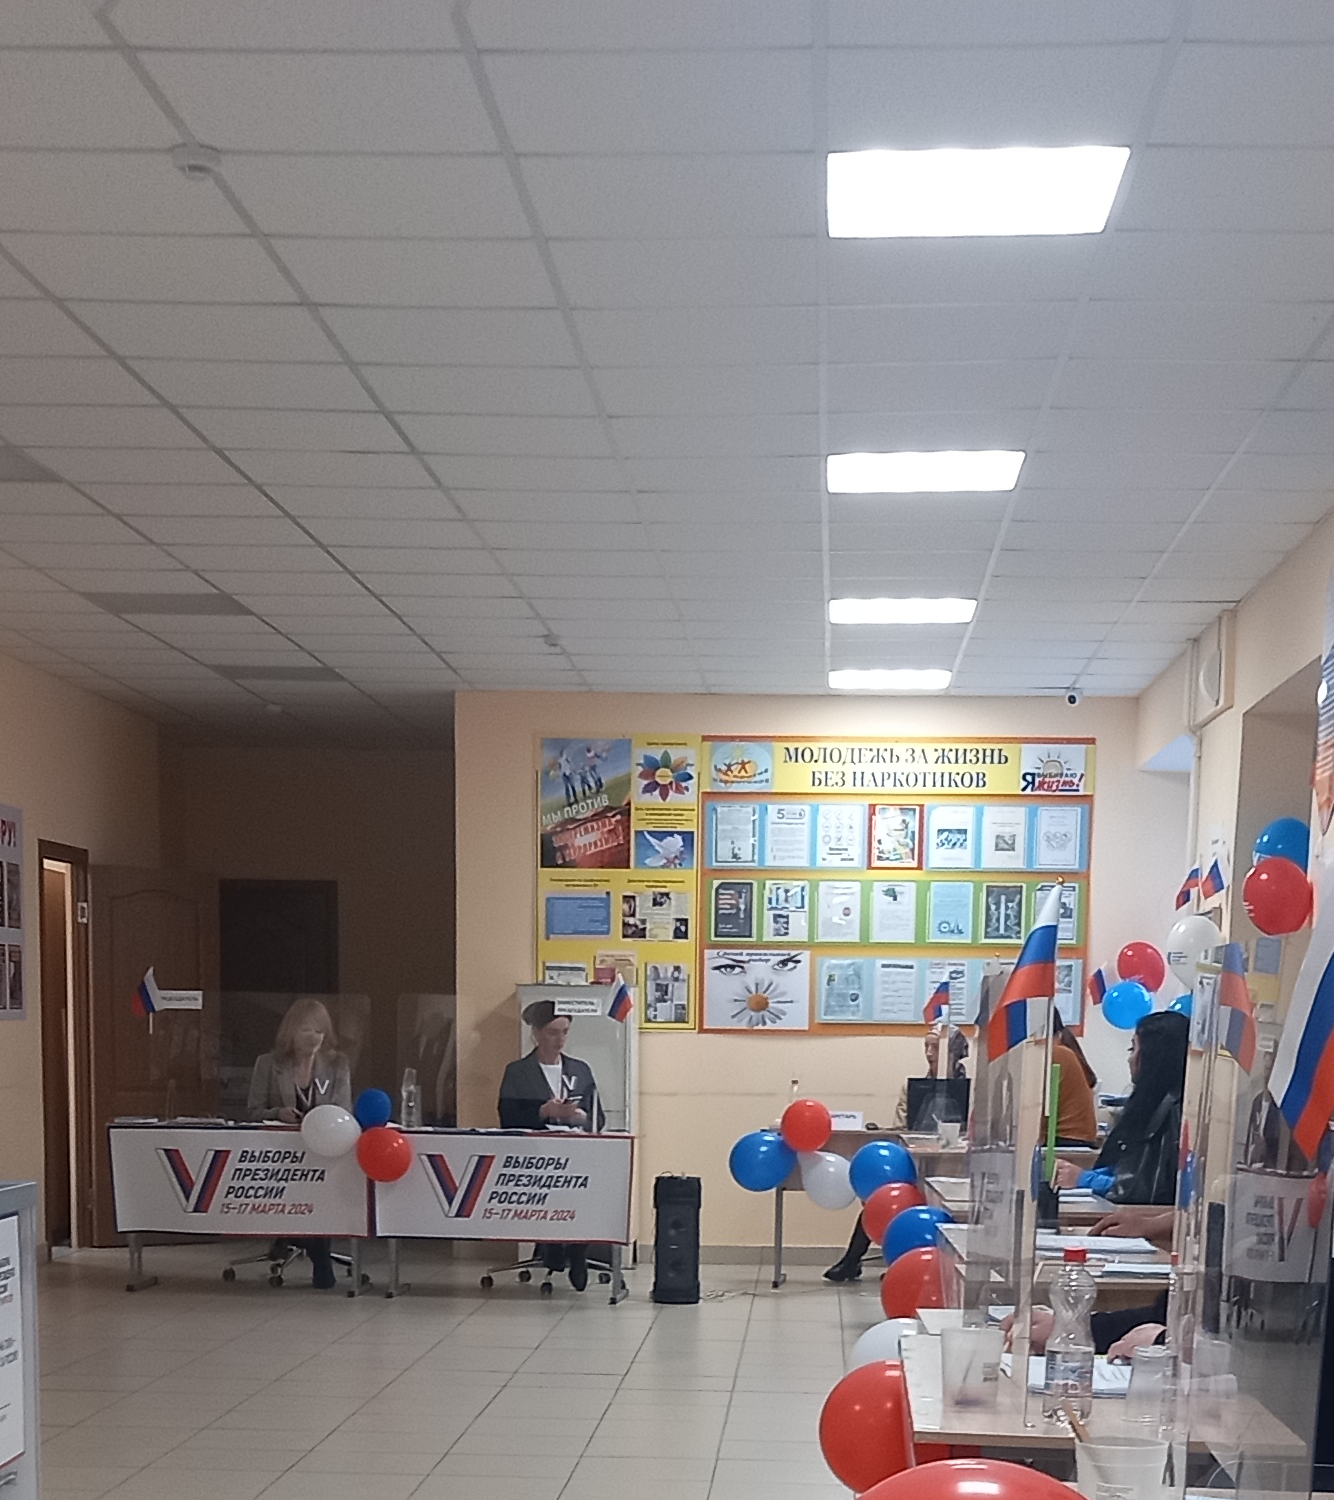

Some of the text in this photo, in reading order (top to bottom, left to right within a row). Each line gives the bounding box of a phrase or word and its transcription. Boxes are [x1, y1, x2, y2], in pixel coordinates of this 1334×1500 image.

[783, 746, 1010, 766] МОЛОДЕЖЬ ЗА ЖИЗНЬ
[811, 769, 988, 789] БЕЗ НАРКОТИКОВ
[1021, 772, 1037, 792] Я
[542, 794, 609, 824] МЫ ПРОТИВ
[237, 1149, 306, 1165] ВЫБОРЫ
[502, 1155, 570, 1171] ВЫБОРЫ
[231, 1167, 326, 1183] ПРЕЗИДЕНТА
[494, 1173, 588, 1189] ПРЕЗИДЕНТА
[224, 1184, 286, 1200] РОССИИ
[488, 1190, 549, 1206] РОССИИ
[250, 1203, 287, 1215] МАРТА
[287, 1203, 315, 1216] 2024
[512, 1209, 549, 1222] МАРТА
[548, 1209, 576, 1222] 2024
